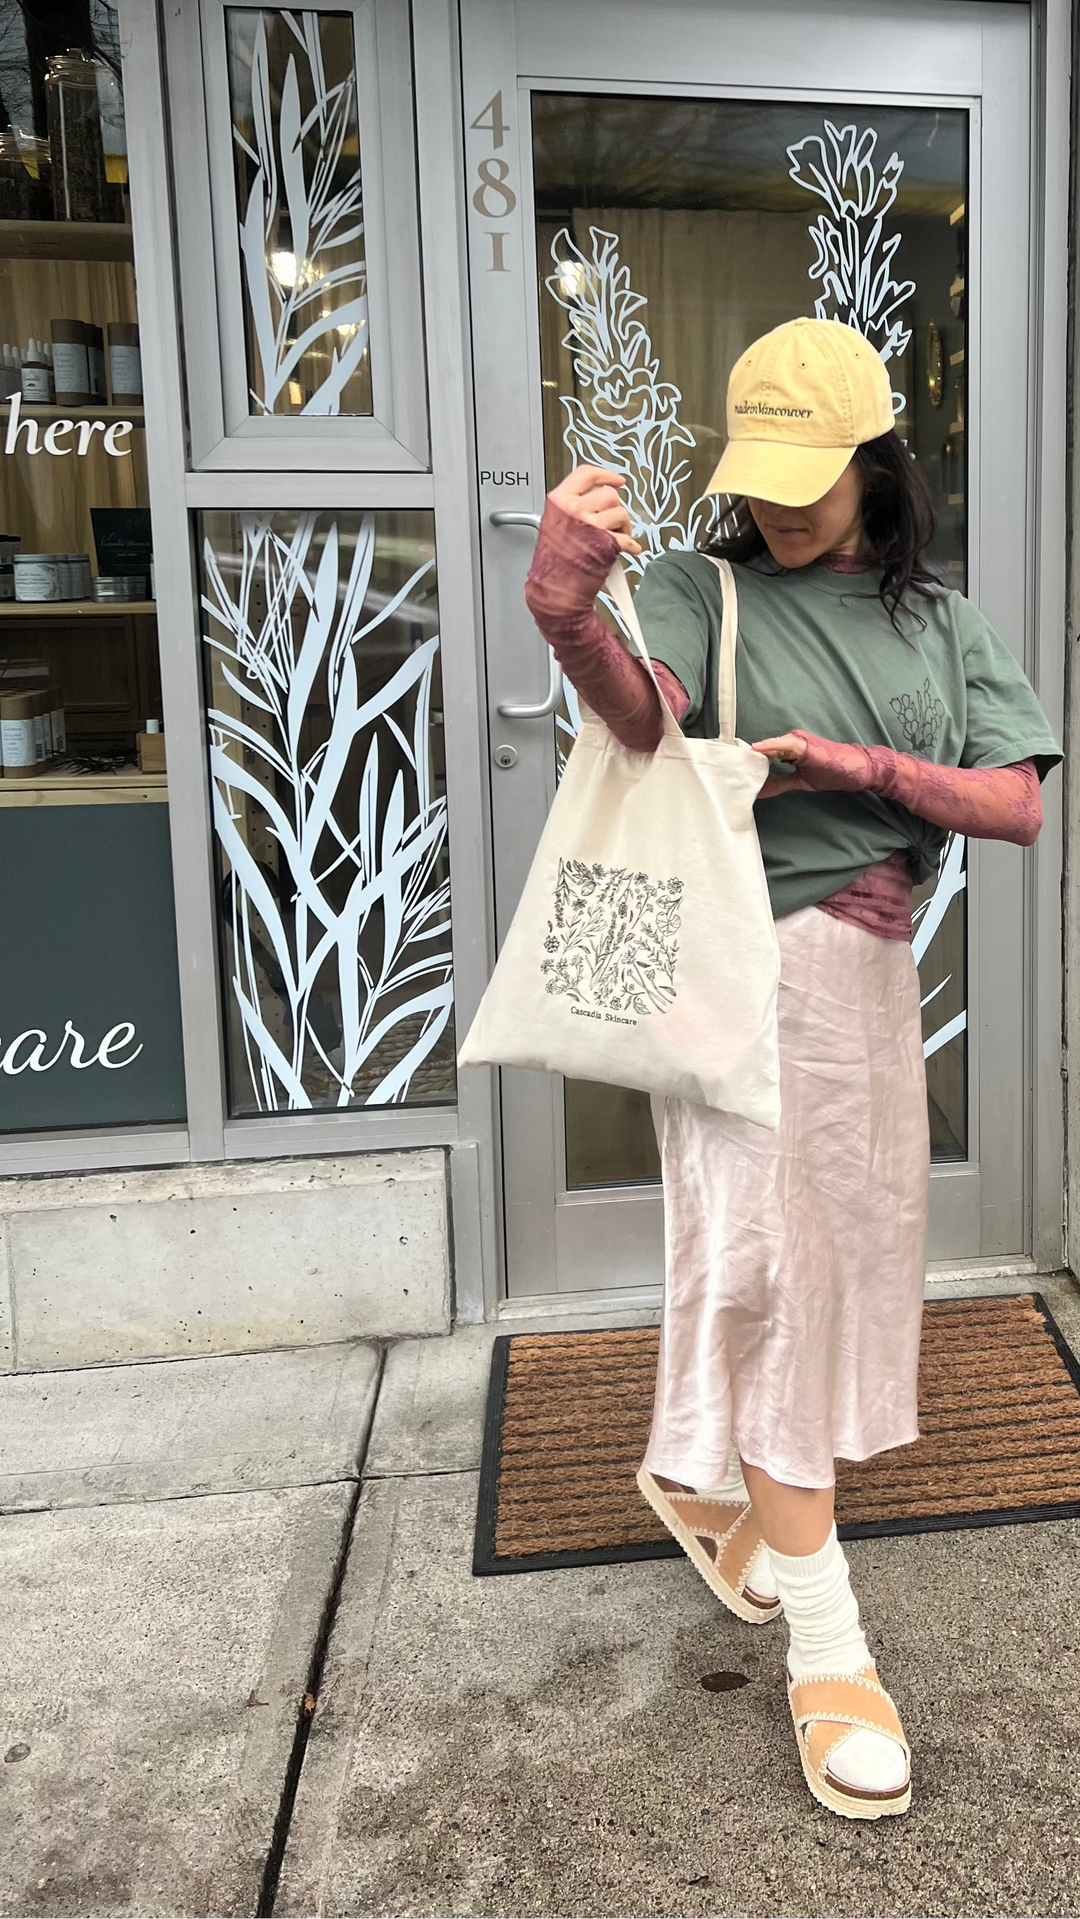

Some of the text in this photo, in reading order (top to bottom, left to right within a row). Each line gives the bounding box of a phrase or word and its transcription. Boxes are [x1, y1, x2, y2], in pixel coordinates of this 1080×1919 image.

[469, 89, 517, 272] 481
[4, 391, 133, 457] here
[480, 470, 529, 486] PUSH
[570, 1006, 638, 1026] Cascadia Skincare
[0, 1019, 144, 1075] are
